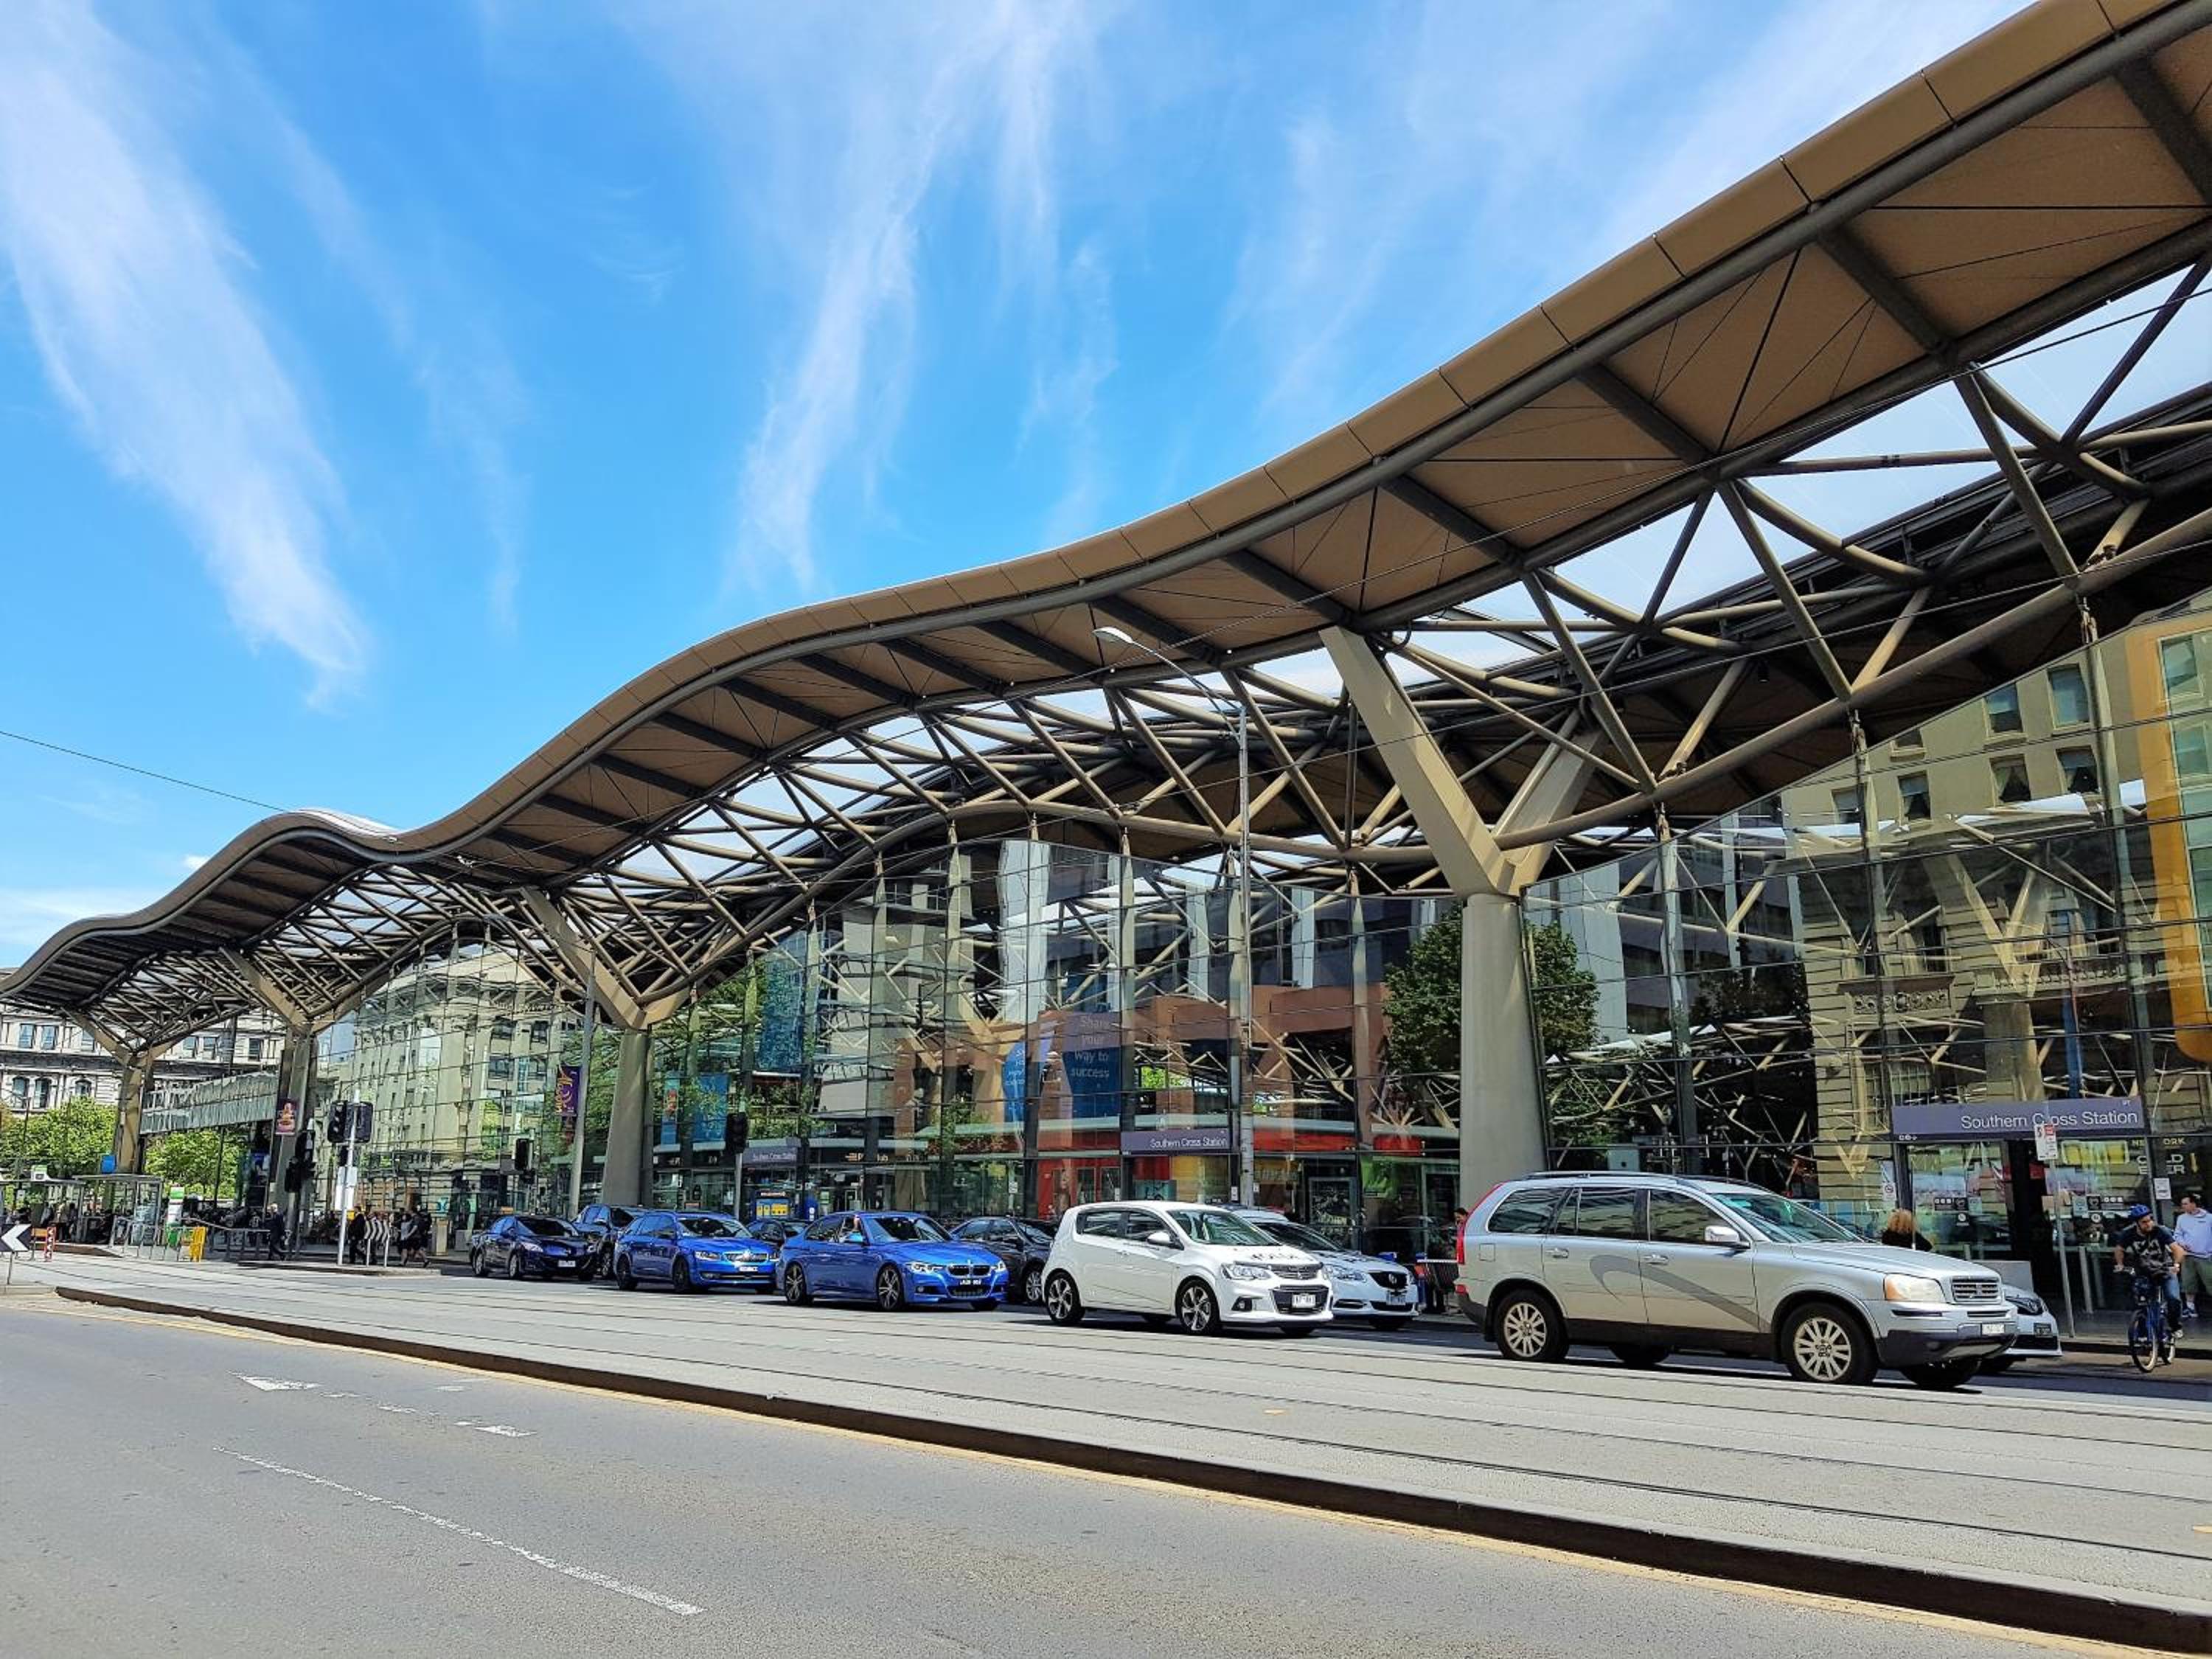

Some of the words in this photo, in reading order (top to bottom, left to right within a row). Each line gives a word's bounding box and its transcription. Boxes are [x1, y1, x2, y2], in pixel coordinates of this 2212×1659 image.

[1961, 1115, 2027, 1130] Southern
[2032, 1112, 2078, 1127] Coss
[2082, 1110, 2138, 1125] Station
[1150, 1138, 1180, 1148] Southern
[1203, 1135, 1227, 1147] Station
